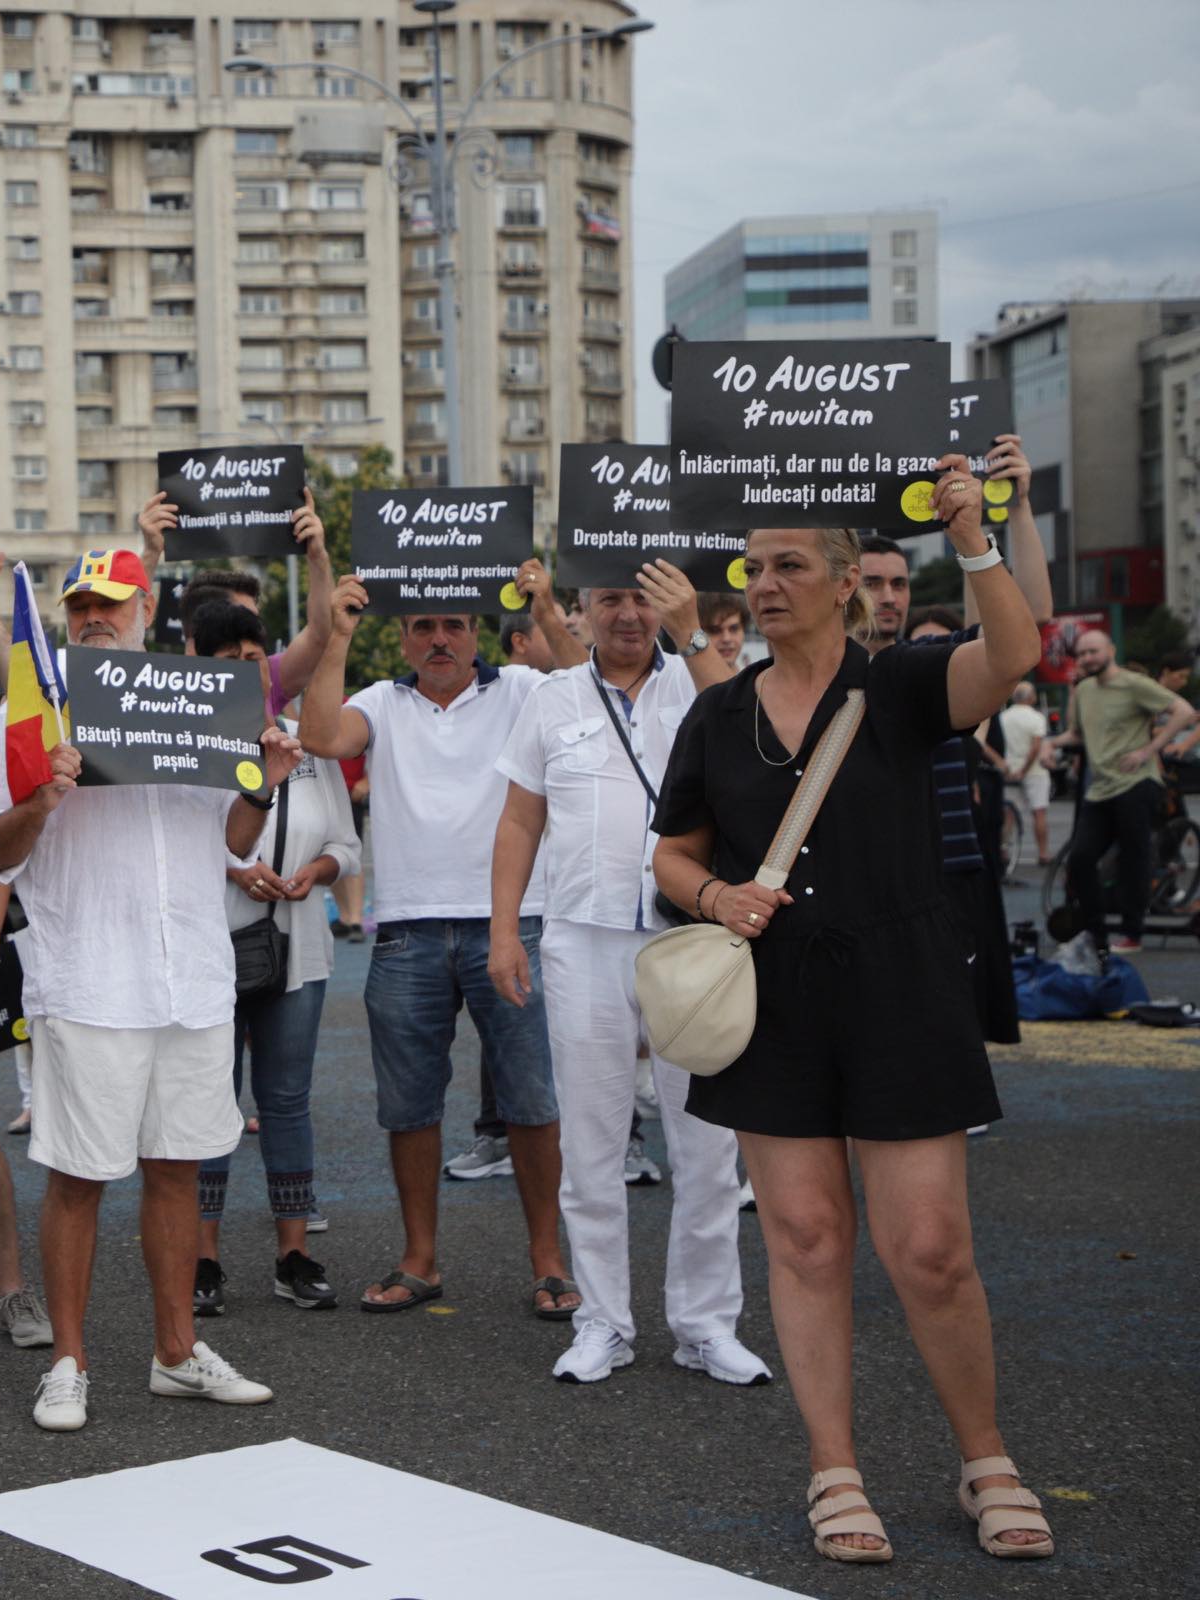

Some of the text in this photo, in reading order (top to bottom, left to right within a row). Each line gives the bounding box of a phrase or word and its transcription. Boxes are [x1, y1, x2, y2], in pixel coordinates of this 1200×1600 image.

[713, 355, 910, 392] 10 AUGUST
[180, 455, 286, 480] 10 AUGUST
[591, 455, 625, 484] 10
[679, 450, 780, 480] Înlăcrimați,
[786, 453, 816, 473] dar
[821, 458, 843, 473] nu
[848, 452, 869, 472] de
[876, 452, 892, 472] la
[742, 482, 876, 510] Judecați odată!
[230, 511, 242, 525] să
[378, 498, 507, 524] 10 AUGUST
[573, 528, 637, 549] Dreptate
[641, 530, 690, 549] pentru
[461, 564, 518, 580] prescriere
[400, 583, 481, 599] Noi, dreptatea.
[95, 659, 234, 693] 10 AUGUST
[76, 725, 261, 756] Bătuți pentru că protestam
[153, 753, 198, 772] pașnic
[200, 1535, 372, 1584] 5
